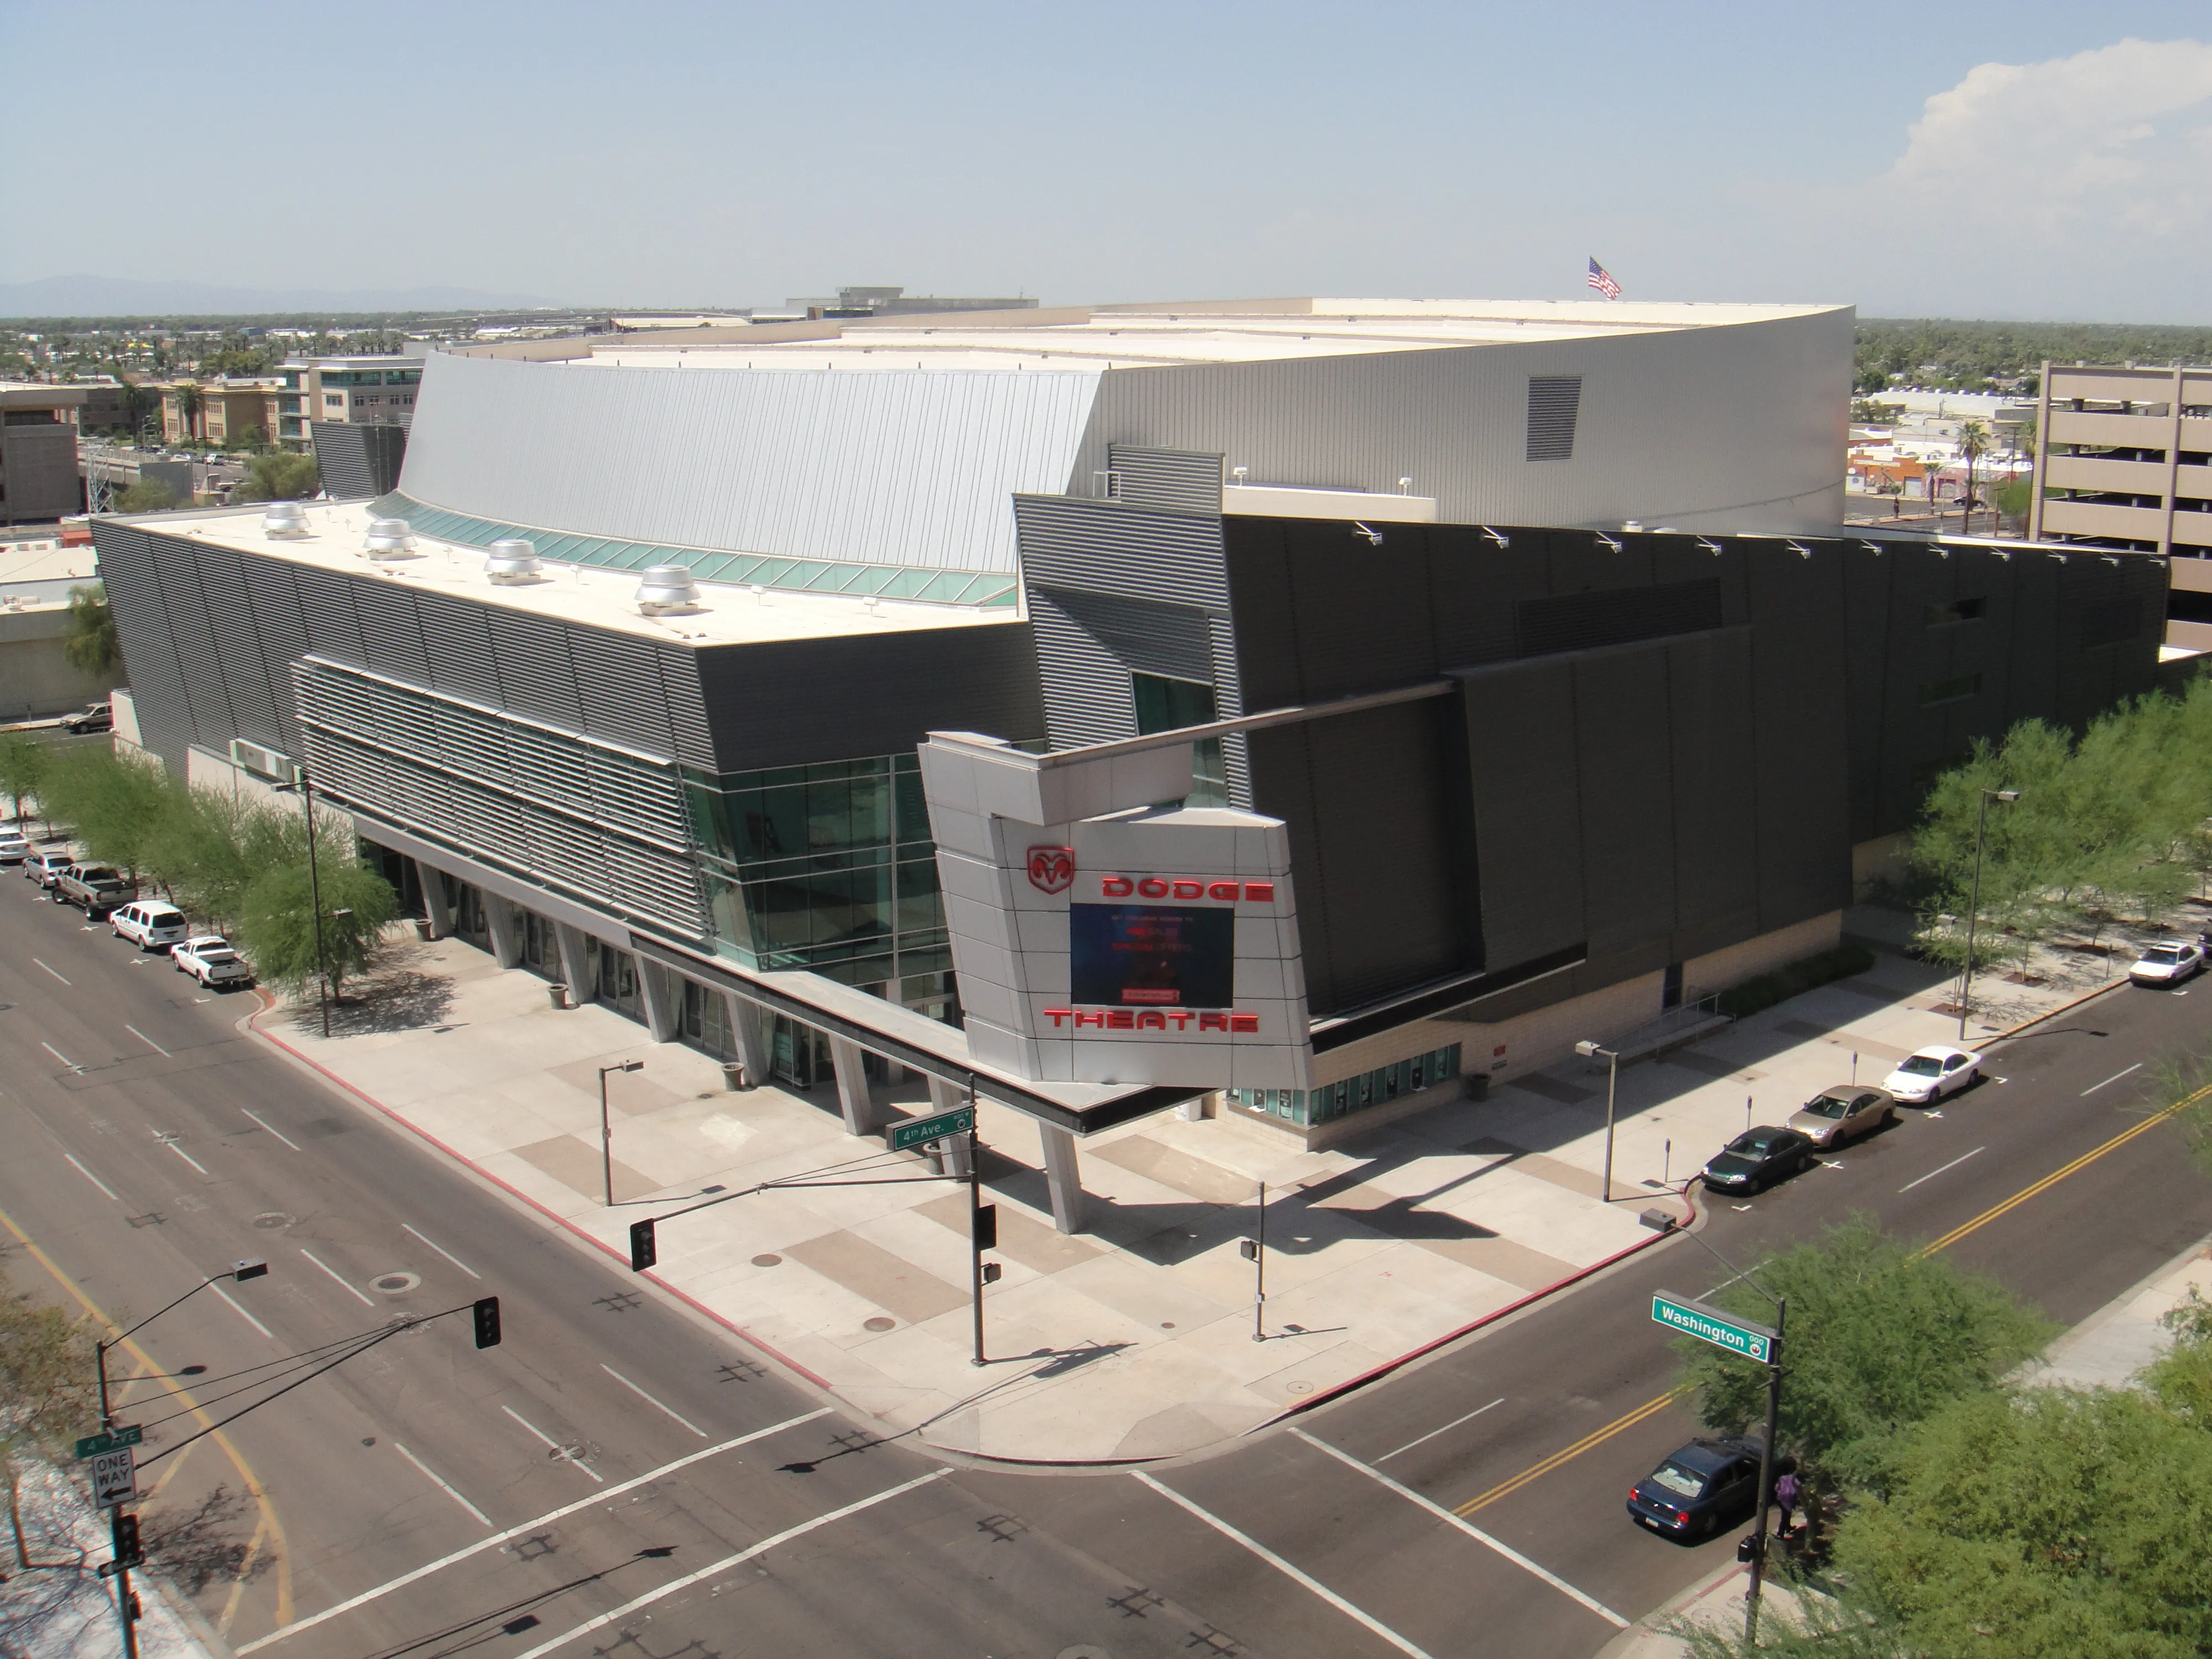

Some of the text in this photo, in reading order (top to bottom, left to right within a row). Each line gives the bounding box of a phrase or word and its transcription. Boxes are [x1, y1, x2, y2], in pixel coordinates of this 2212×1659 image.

[1102, 878, 1274, 902] DODGE
[1044, 1009, 1259, 1033] THEATRE
[904, 1124, 944, 1141] 4th Ave.
[1662, 1305, 1744, 1347] Washington
[1750, 1335, 1764, 1345] 000
[98, 1453, 128, 1471] ONE
[98, 1468, 129, 1486] WAY
